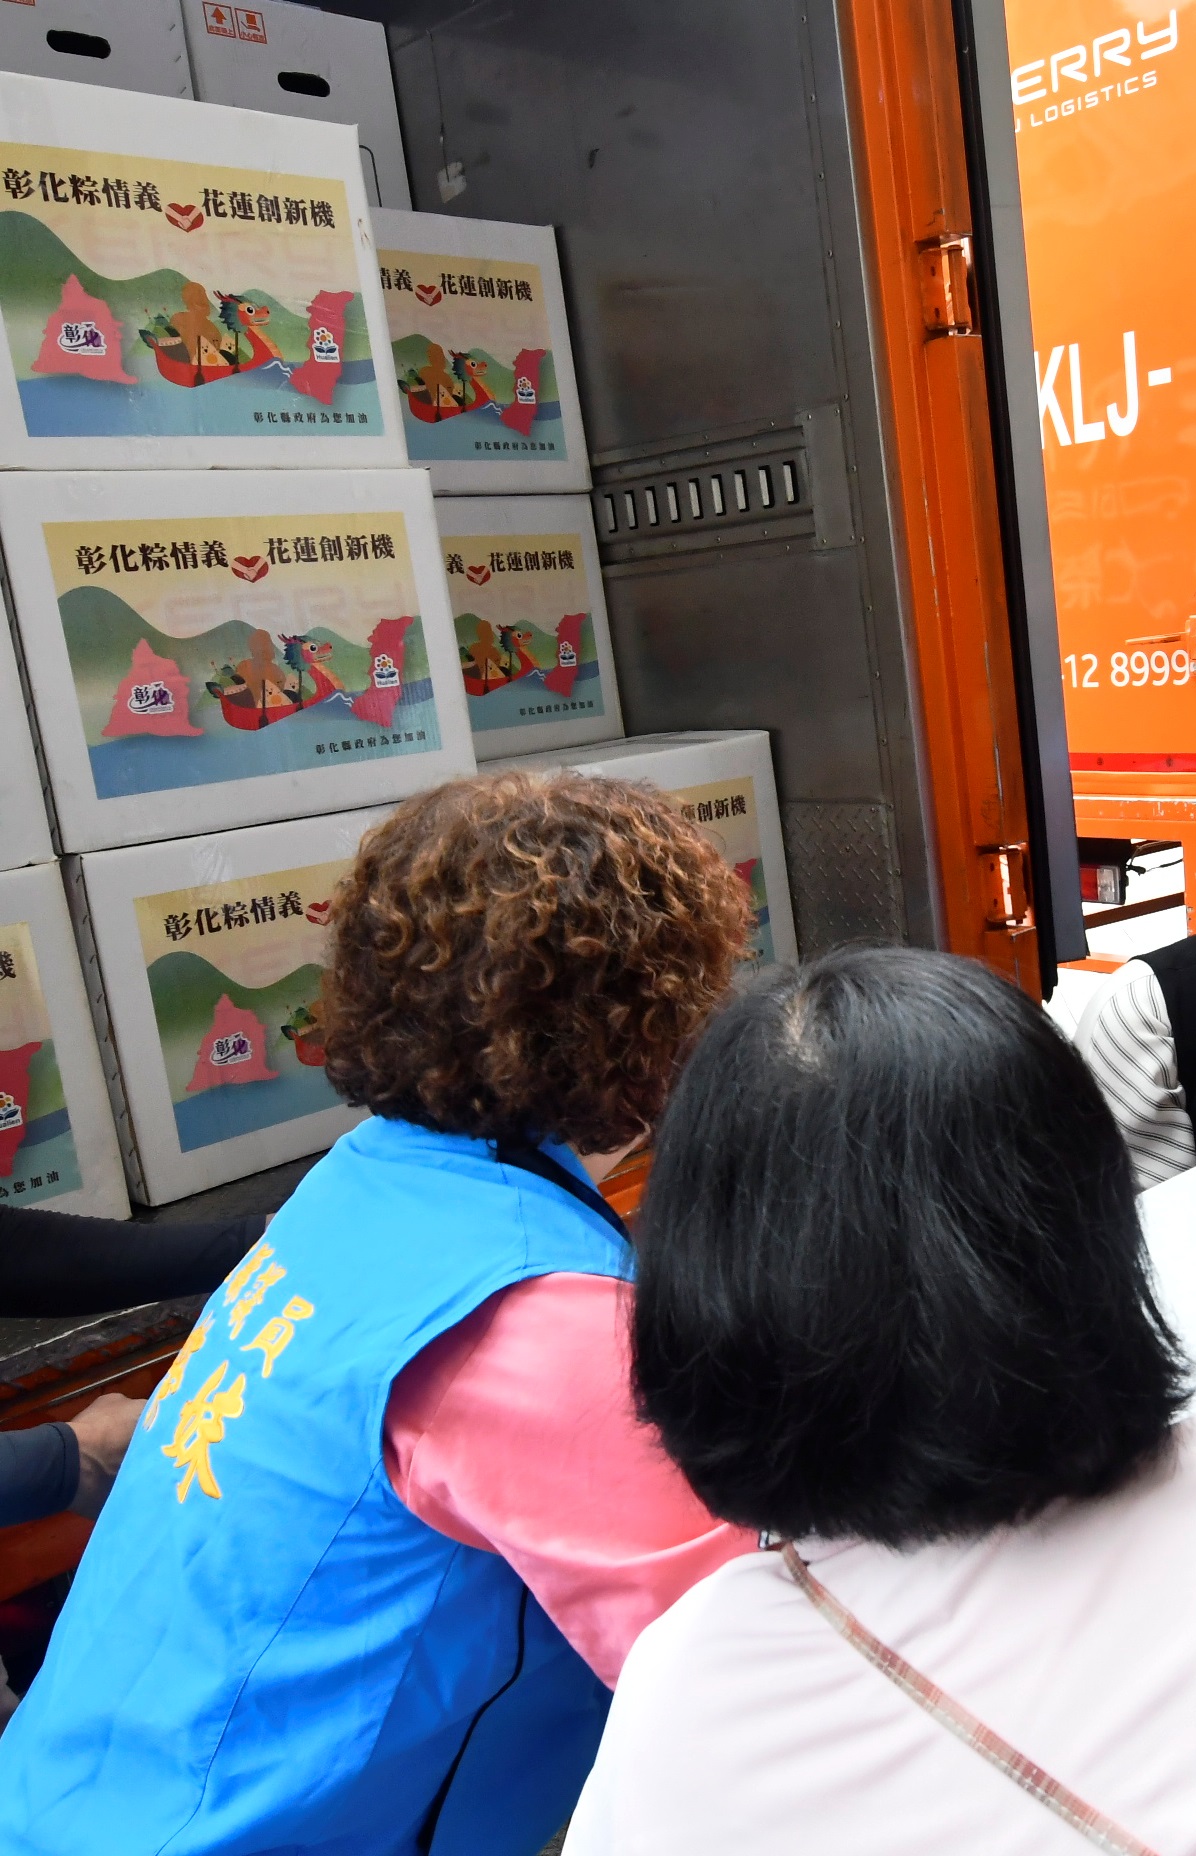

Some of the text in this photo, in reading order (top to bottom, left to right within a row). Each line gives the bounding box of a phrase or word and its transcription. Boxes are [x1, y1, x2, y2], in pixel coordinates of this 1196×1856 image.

[1011, 9, 1178, 105] ERRY
[1030, 70, 1157, 127] LOGISTICS
[2, 168, 336, 230] 彰化粽情義 花蓮創新機
[439, 272, 534, 302] 花蓮創新機
[253, 411, 369, 425] 彰化縣政府為您加油
[75, 533, 396, 576] 彰化粽情義 花蓮創新機
[488, 550, 575, 573] 花蓮創新機
[1062, 650, 1191, 688] 12 8999
[316, 730, 426, 755] 彰化縣政府為您加油
[164, 890, 304, 942] 彰化粽情義
